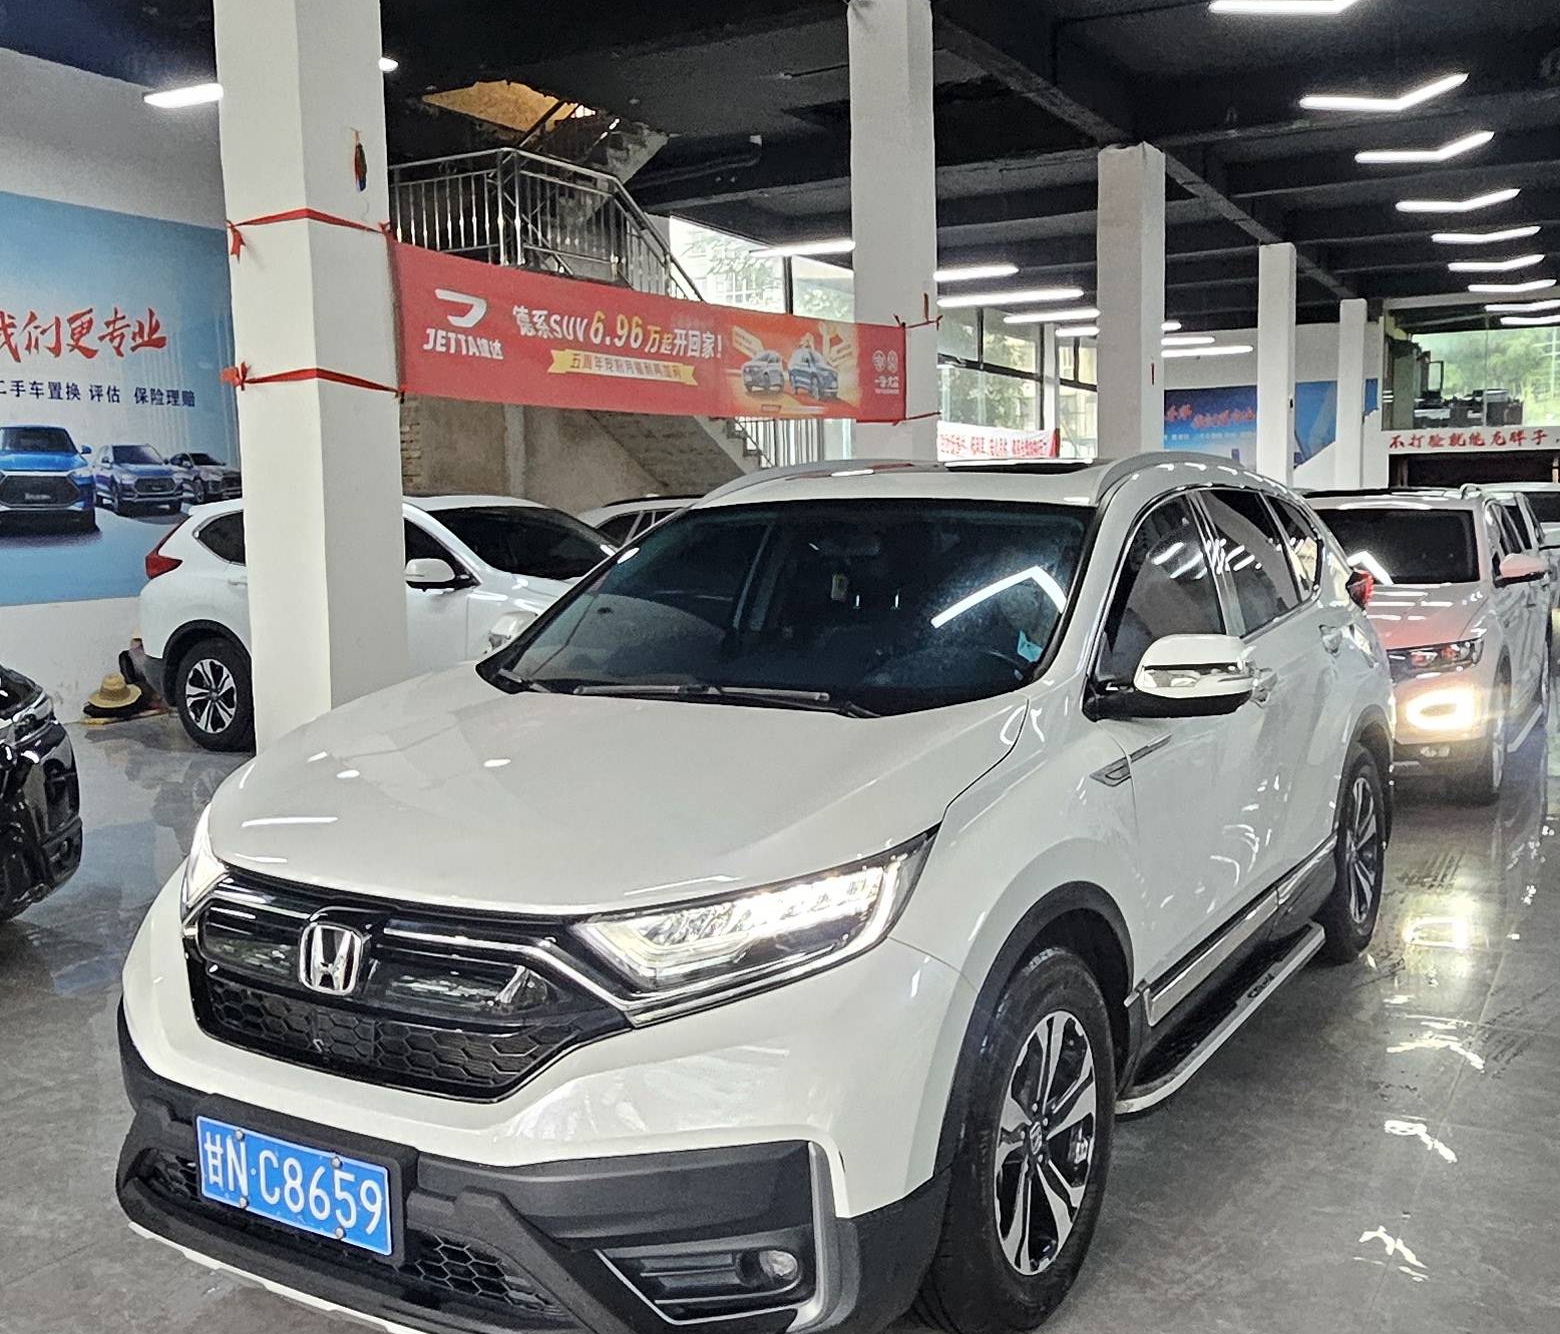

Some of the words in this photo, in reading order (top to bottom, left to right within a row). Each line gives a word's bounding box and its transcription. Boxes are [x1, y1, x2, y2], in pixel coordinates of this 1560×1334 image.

[89, 384, 121, 404] 评估
[134, 386, 196, 407] 保险理赔
